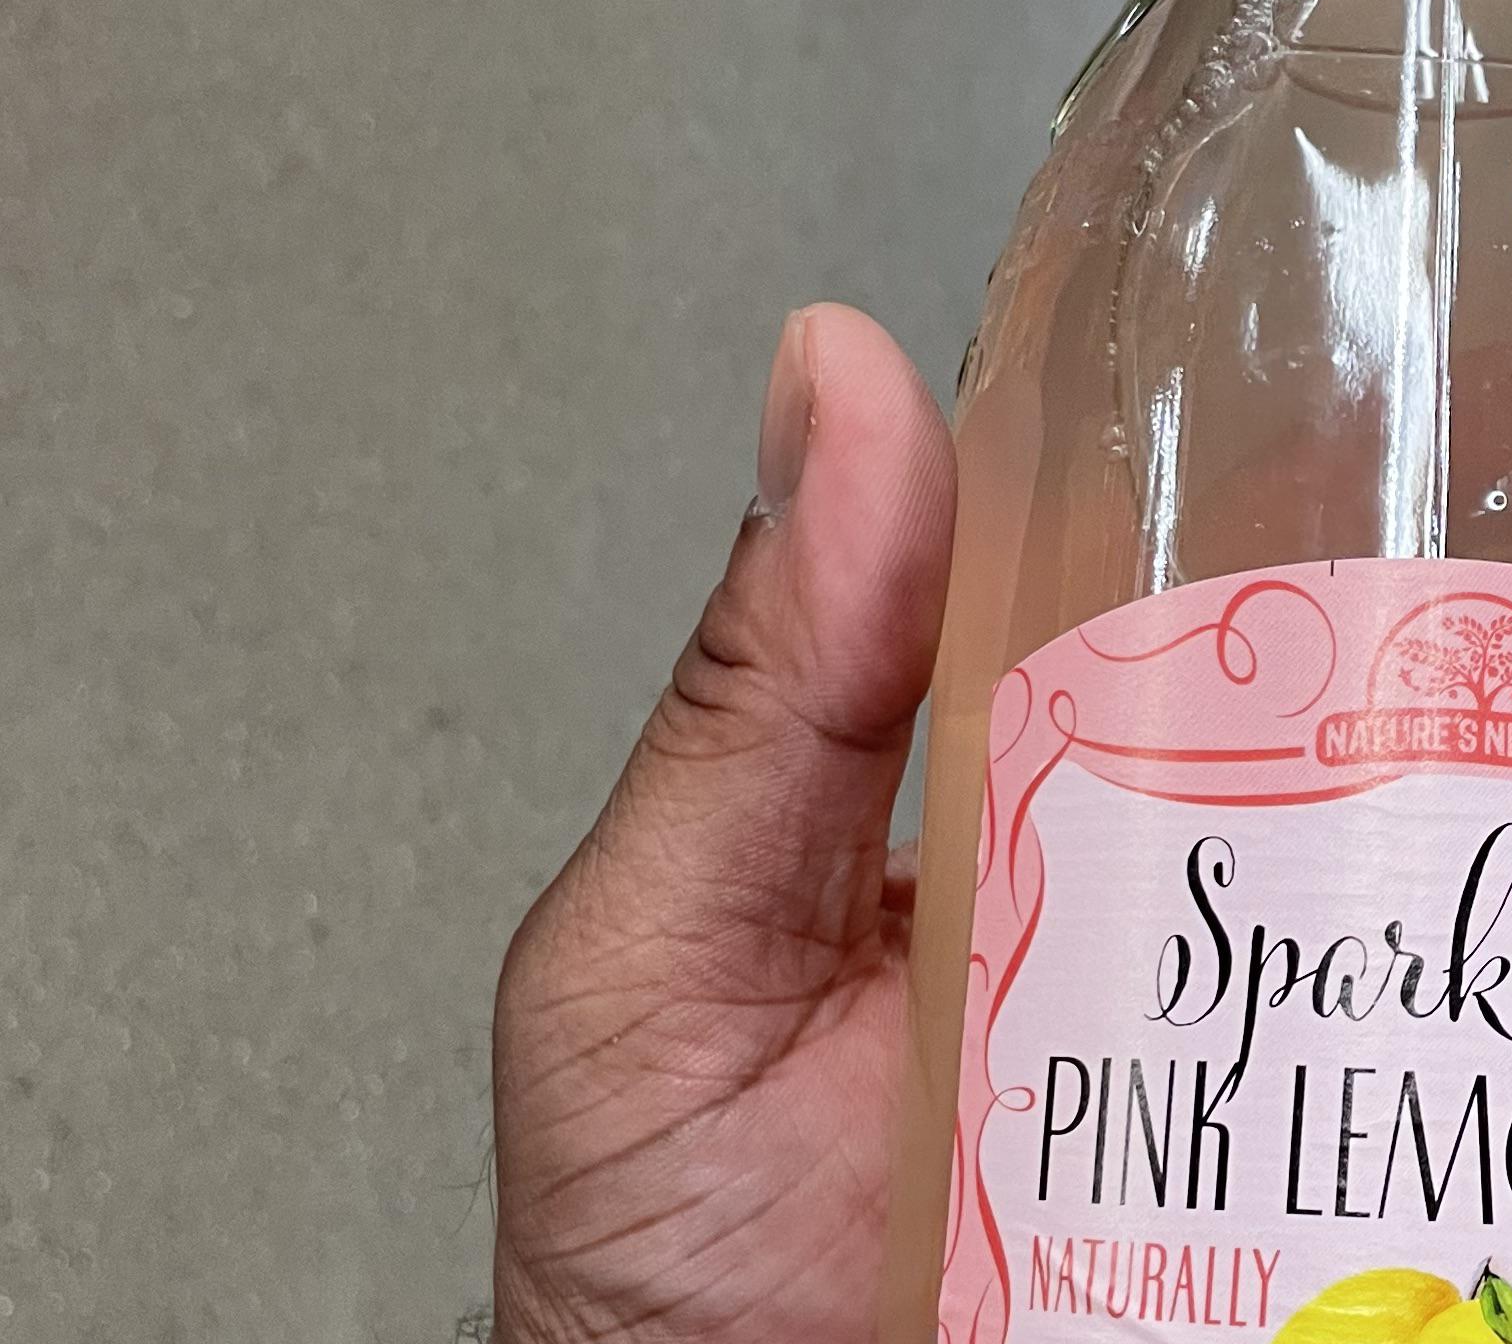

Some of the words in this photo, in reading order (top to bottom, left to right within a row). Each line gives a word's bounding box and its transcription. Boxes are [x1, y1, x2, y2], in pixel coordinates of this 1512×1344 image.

[1324, 713, 1479, 758] NATURE'S
[1037, 1055, 1238, 1212] PINK
[1027, 1234, 1282, 1329] NATURALLY
